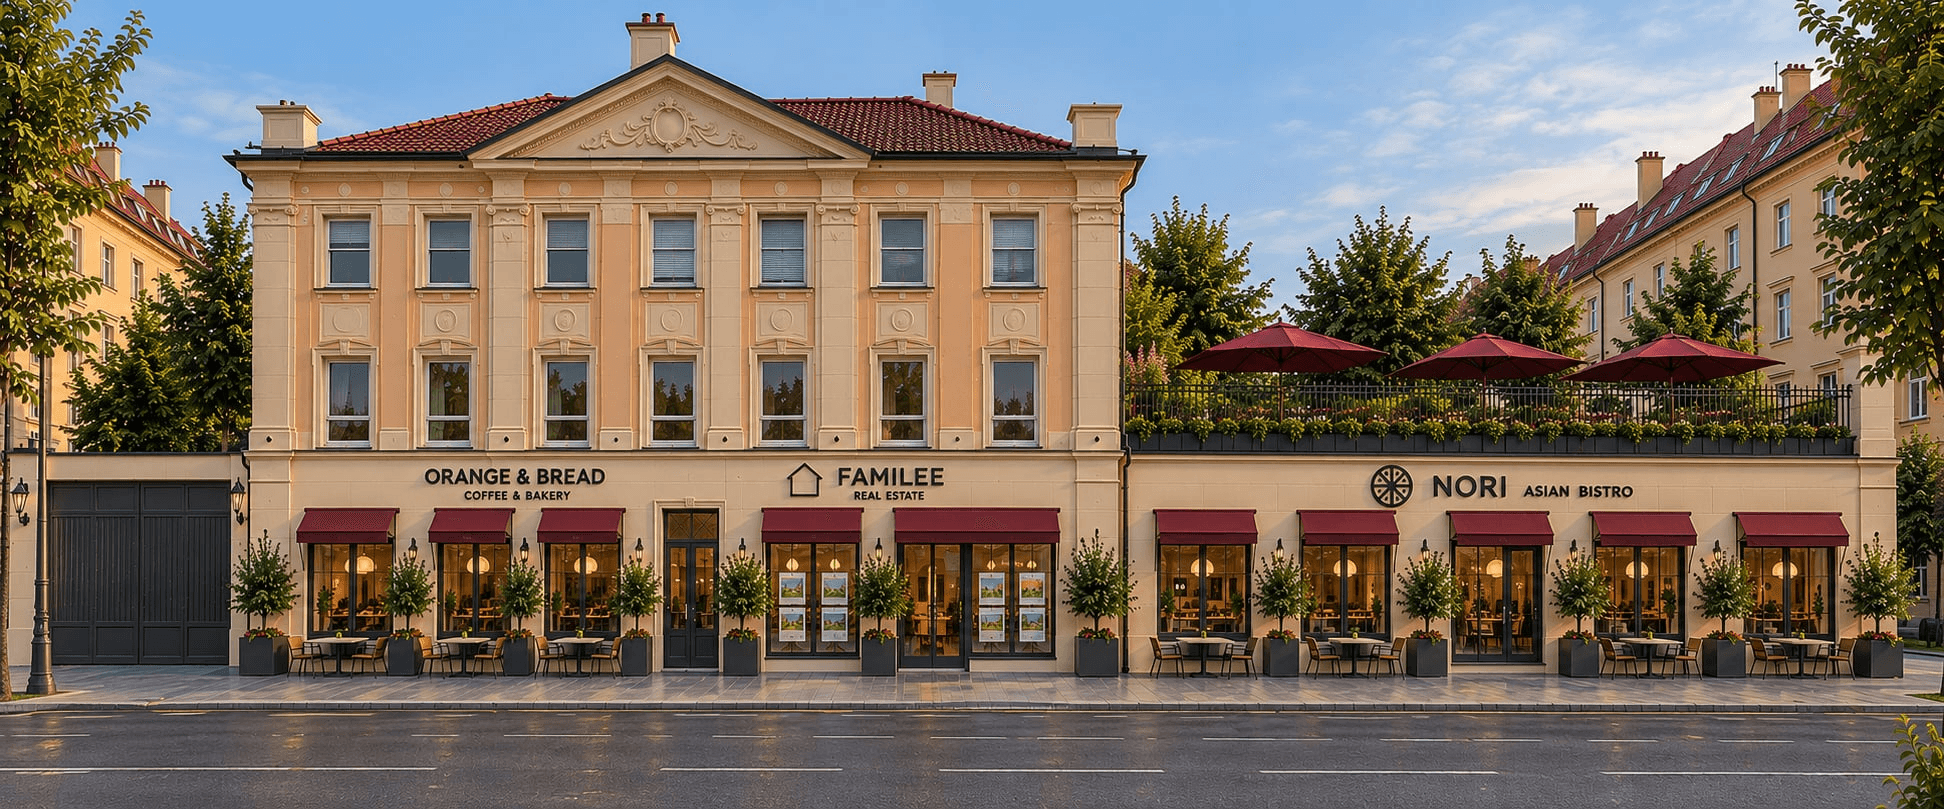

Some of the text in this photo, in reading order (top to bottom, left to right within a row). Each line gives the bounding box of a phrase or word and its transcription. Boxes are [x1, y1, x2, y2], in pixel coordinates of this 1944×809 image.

[424, 467, 606, 486] ORANGE & BREAD
[838, 467, 945, 487] FAMILEE
[463, 490, 571, 501] COFFEE & BAKERY
[853, 490, 925, 501] REAL ESTATE
[1432, 475, 1634, 498] NORI ASIAN BISTRO
